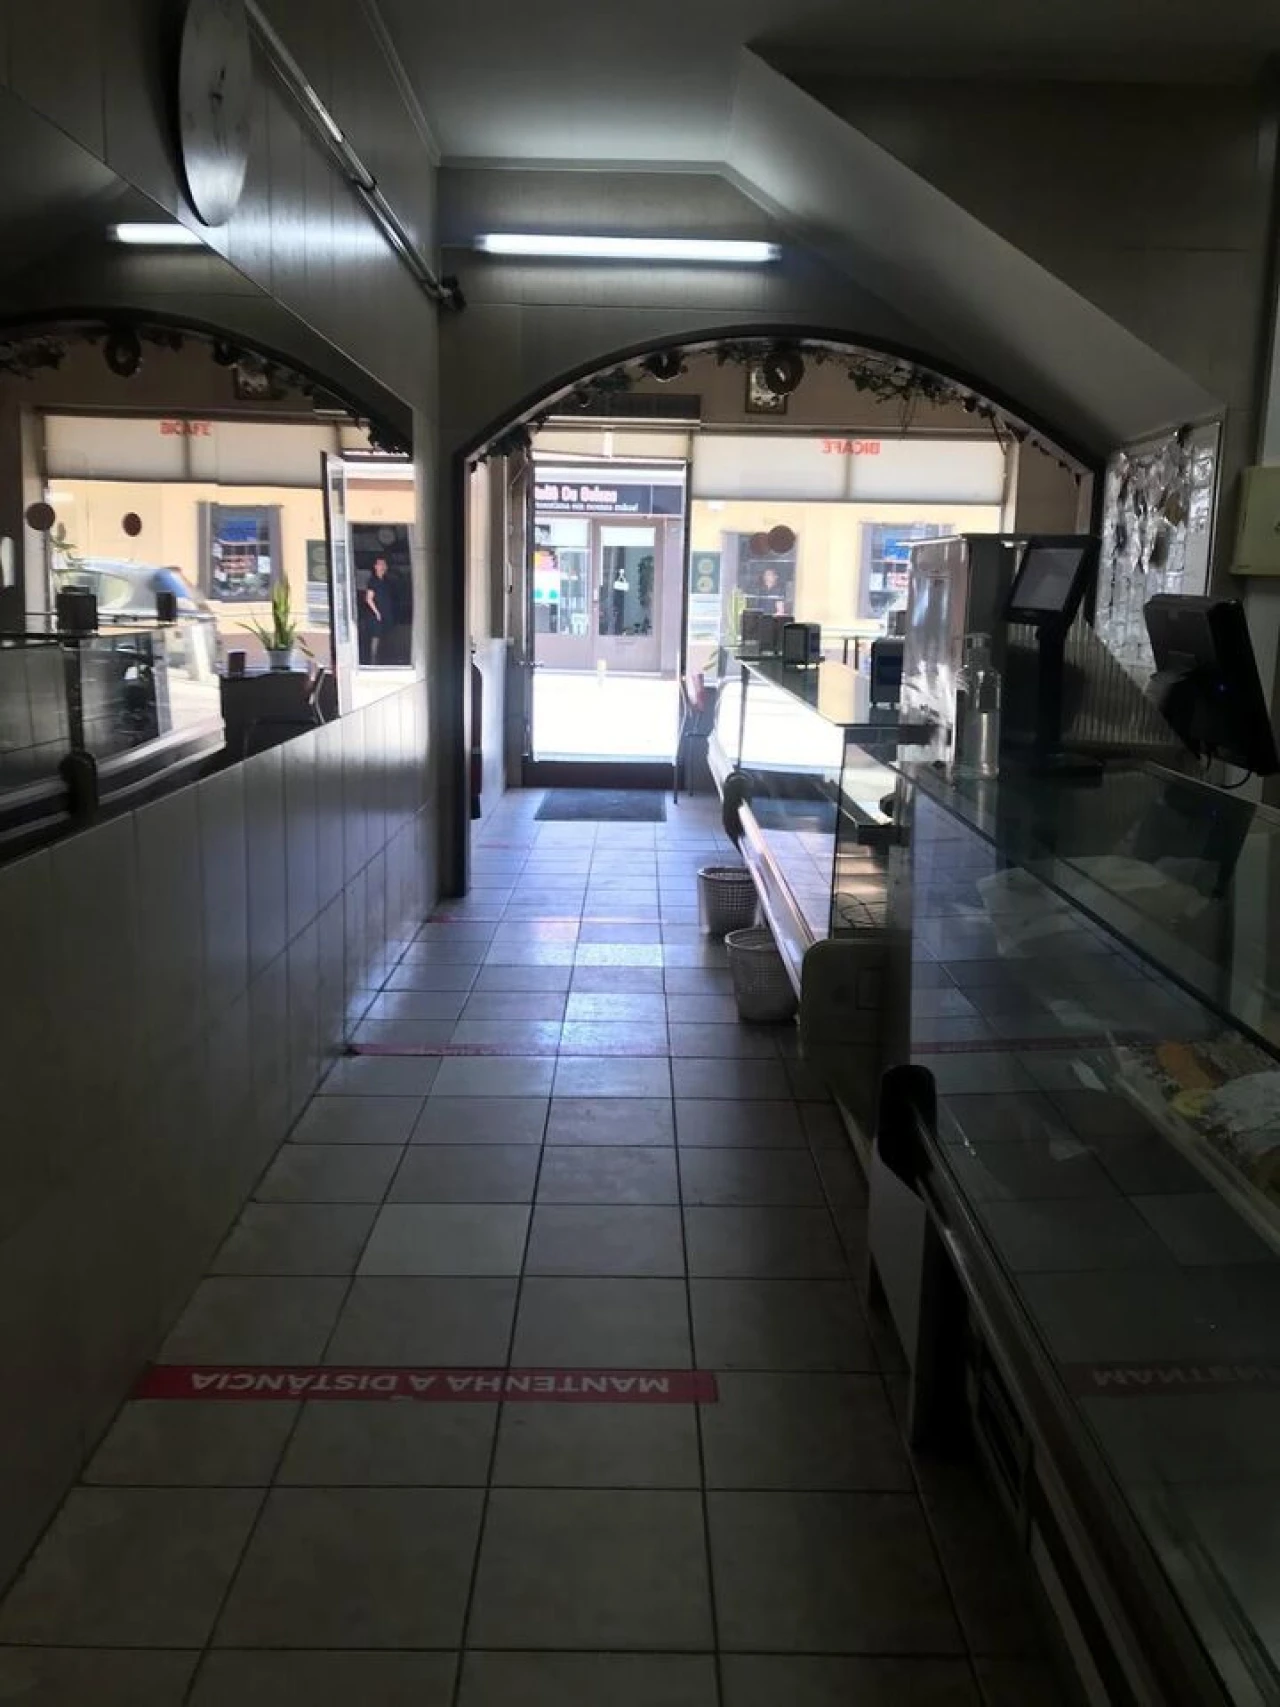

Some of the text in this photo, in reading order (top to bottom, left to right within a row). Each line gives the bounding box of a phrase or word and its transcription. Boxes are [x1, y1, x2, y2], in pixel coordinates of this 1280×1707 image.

[190, 1372, 670, 1394] MANTENHA A DISTÂNCIA
